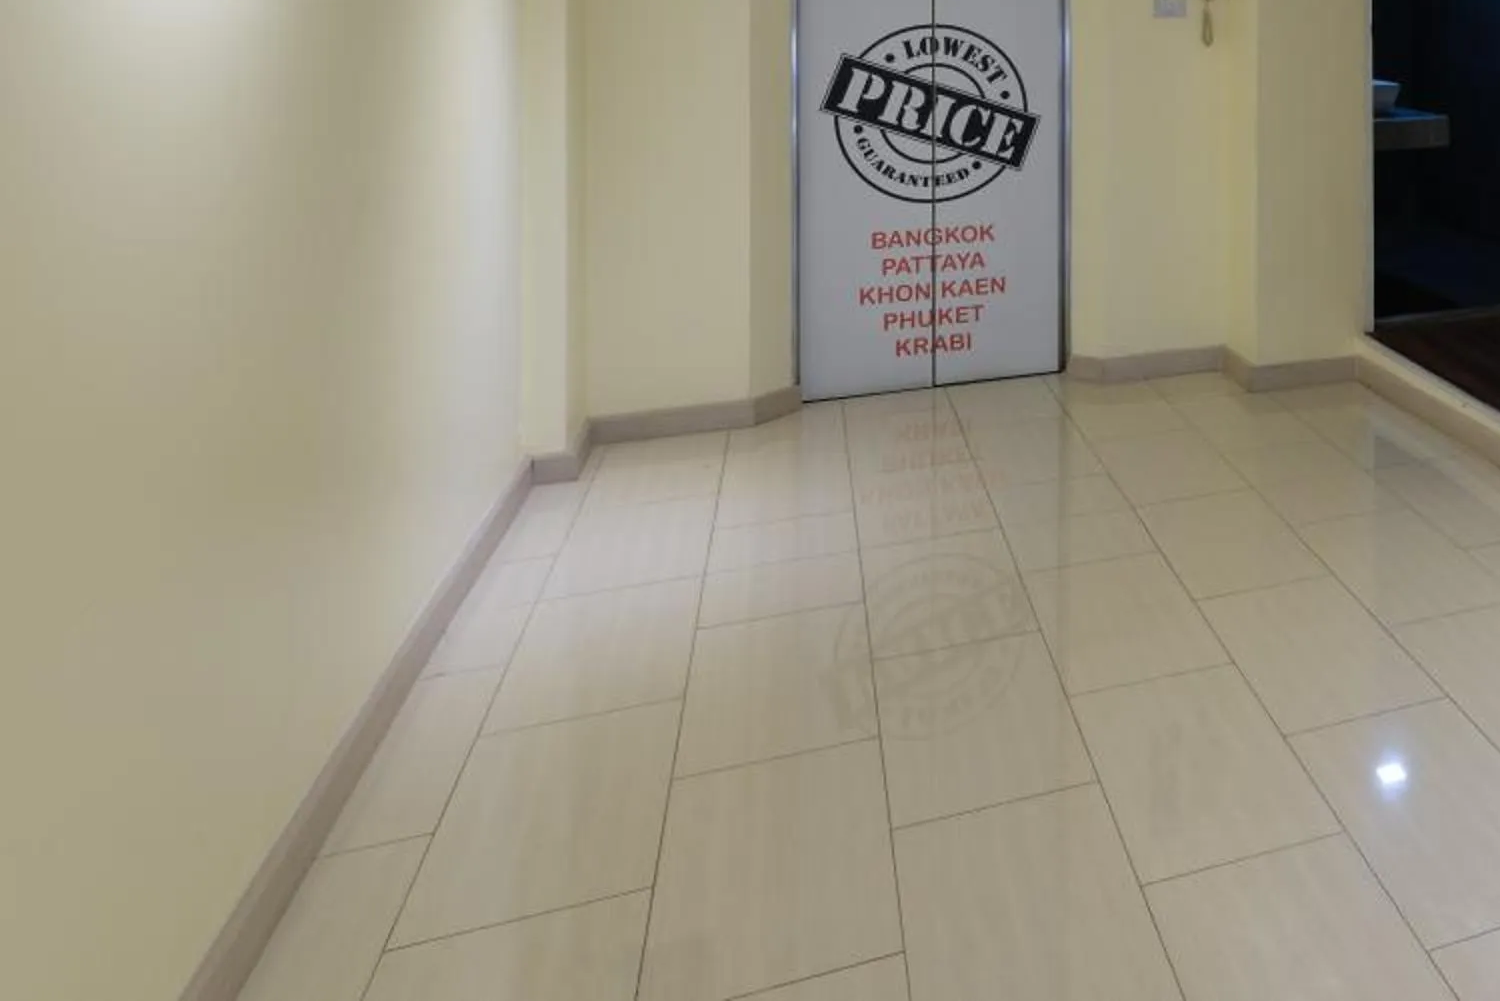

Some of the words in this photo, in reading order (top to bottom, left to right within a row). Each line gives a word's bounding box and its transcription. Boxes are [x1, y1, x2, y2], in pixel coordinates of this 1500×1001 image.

[902, 36, 1009, 84] LOWEST
[836, 67, 1026, 160] PRICE
[856, 137, 971, 188] GUARANTEED
[871, 224, 995, 250] BANGKOK
[882, 251, 986, 277] PATTAYA
[859, 282, 931, 305] KHON
[941, 276, 1007, 299] KAEN
[883, 304, 985, 331] PHUKET
[895, 332, 972, 358] KRABI
